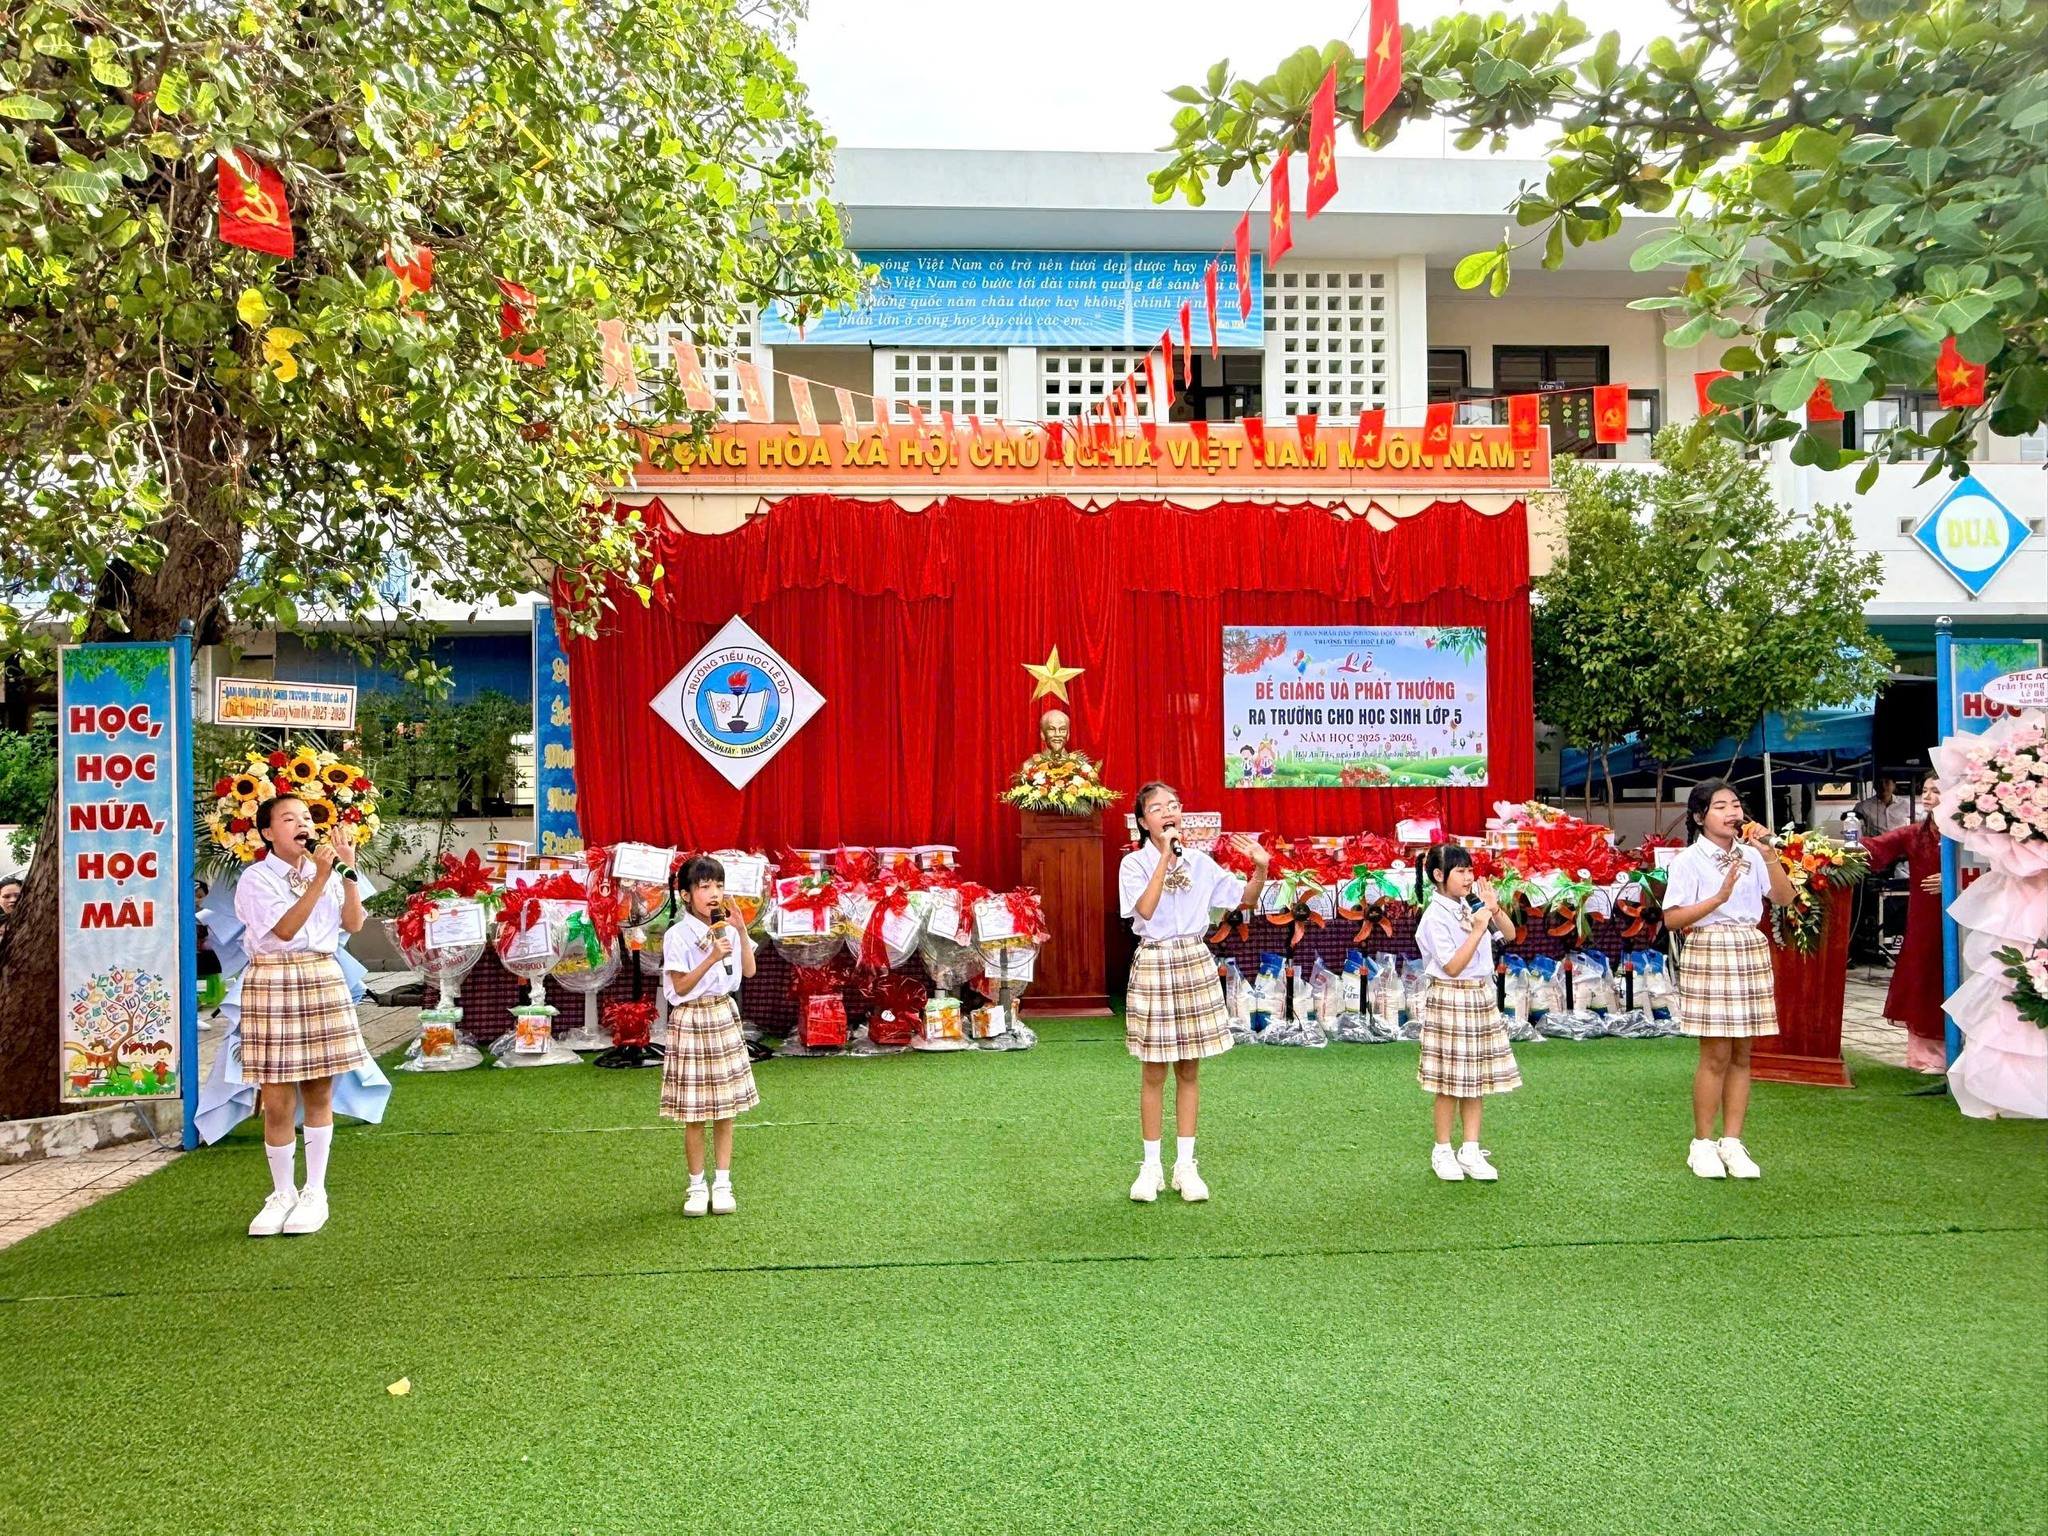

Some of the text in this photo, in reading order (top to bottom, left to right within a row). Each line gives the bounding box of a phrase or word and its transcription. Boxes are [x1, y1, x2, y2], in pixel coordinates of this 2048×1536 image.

[918, 257, 945, 272] Việt
[952, 257, 983, 271] Nam
[989, 258, 1004, 271] có
[1173, 259, 1197, 274] hay
[895, 276, 922, 290] Việt
[925, 276, 957, 289] Nam
[962, 277, 977, 289] có
[1055, 295, 1080, 310] hay
[69, 705, 163, 740] HỌC,
[1248, 708, 1266, 725] RA
[1327, 708, 1354, 725] CHO
[1359, 708, 1385, 728] HỌC
[1390, 708, 1421, 725] SINH
[1426, 705, 1450, 725] LỚP
[1454, 708, 1462, 725] 5
[1299, 731, 1326, 743] NĂM
[1329, 733, 1354, 744] HỌC
[1357, 733, 1381, 742] 2025
[1389, 733, 1413, 742] 2026
[76, 754, 156, 788] HỌC
[69, 799, 165, 835] NỮA,
[77, 851, 157, 886] HỌC
[79, 896, 154, 929] MÃI
